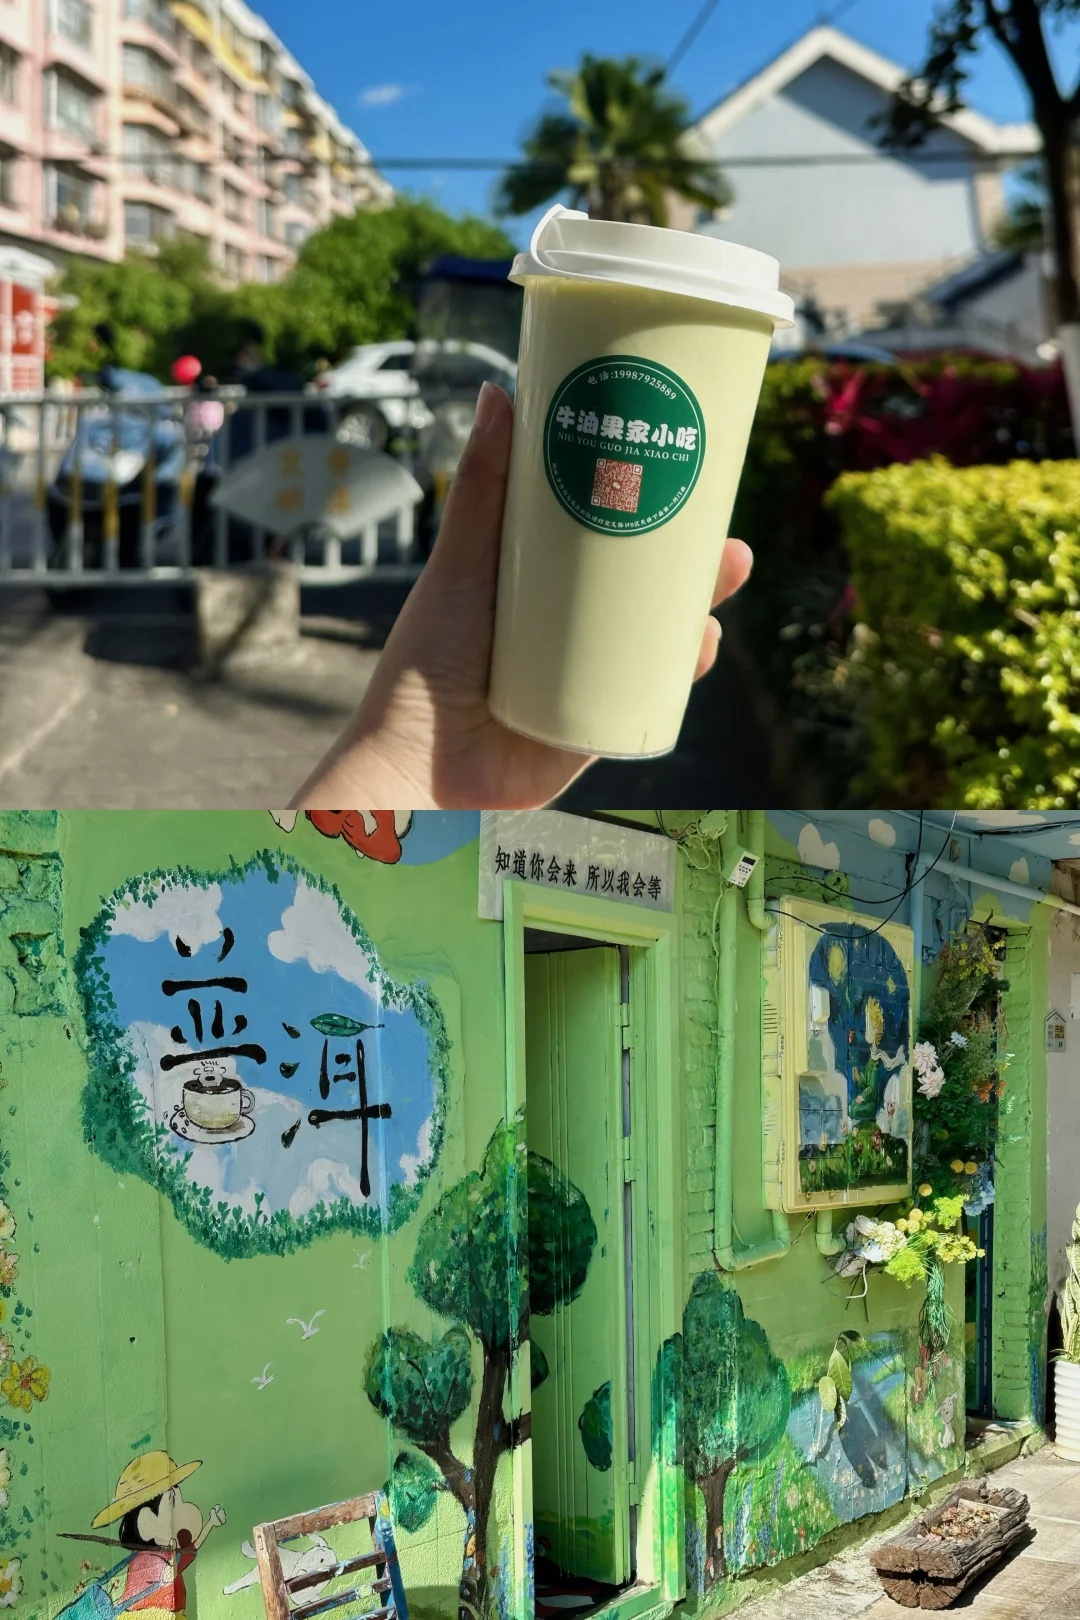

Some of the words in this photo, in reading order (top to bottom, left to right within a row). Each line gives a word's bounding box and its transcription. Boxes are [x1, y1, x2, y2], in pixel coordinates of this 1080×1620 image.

[555, 406, 698, 451] 牛油果家小吃
[557, 432, 575, 442] NIU
[577, 436, 597, 447] YOU
[600, 441, 622, 452] GUO
[625, 446, 640, 456] JIA
[644, 449, 669, 460] XIAO
[672, 453, 689, 461] CHI
[494, 845, 577, 887] 知道你会来
[586, 864, 662, 901] 所以我会等
